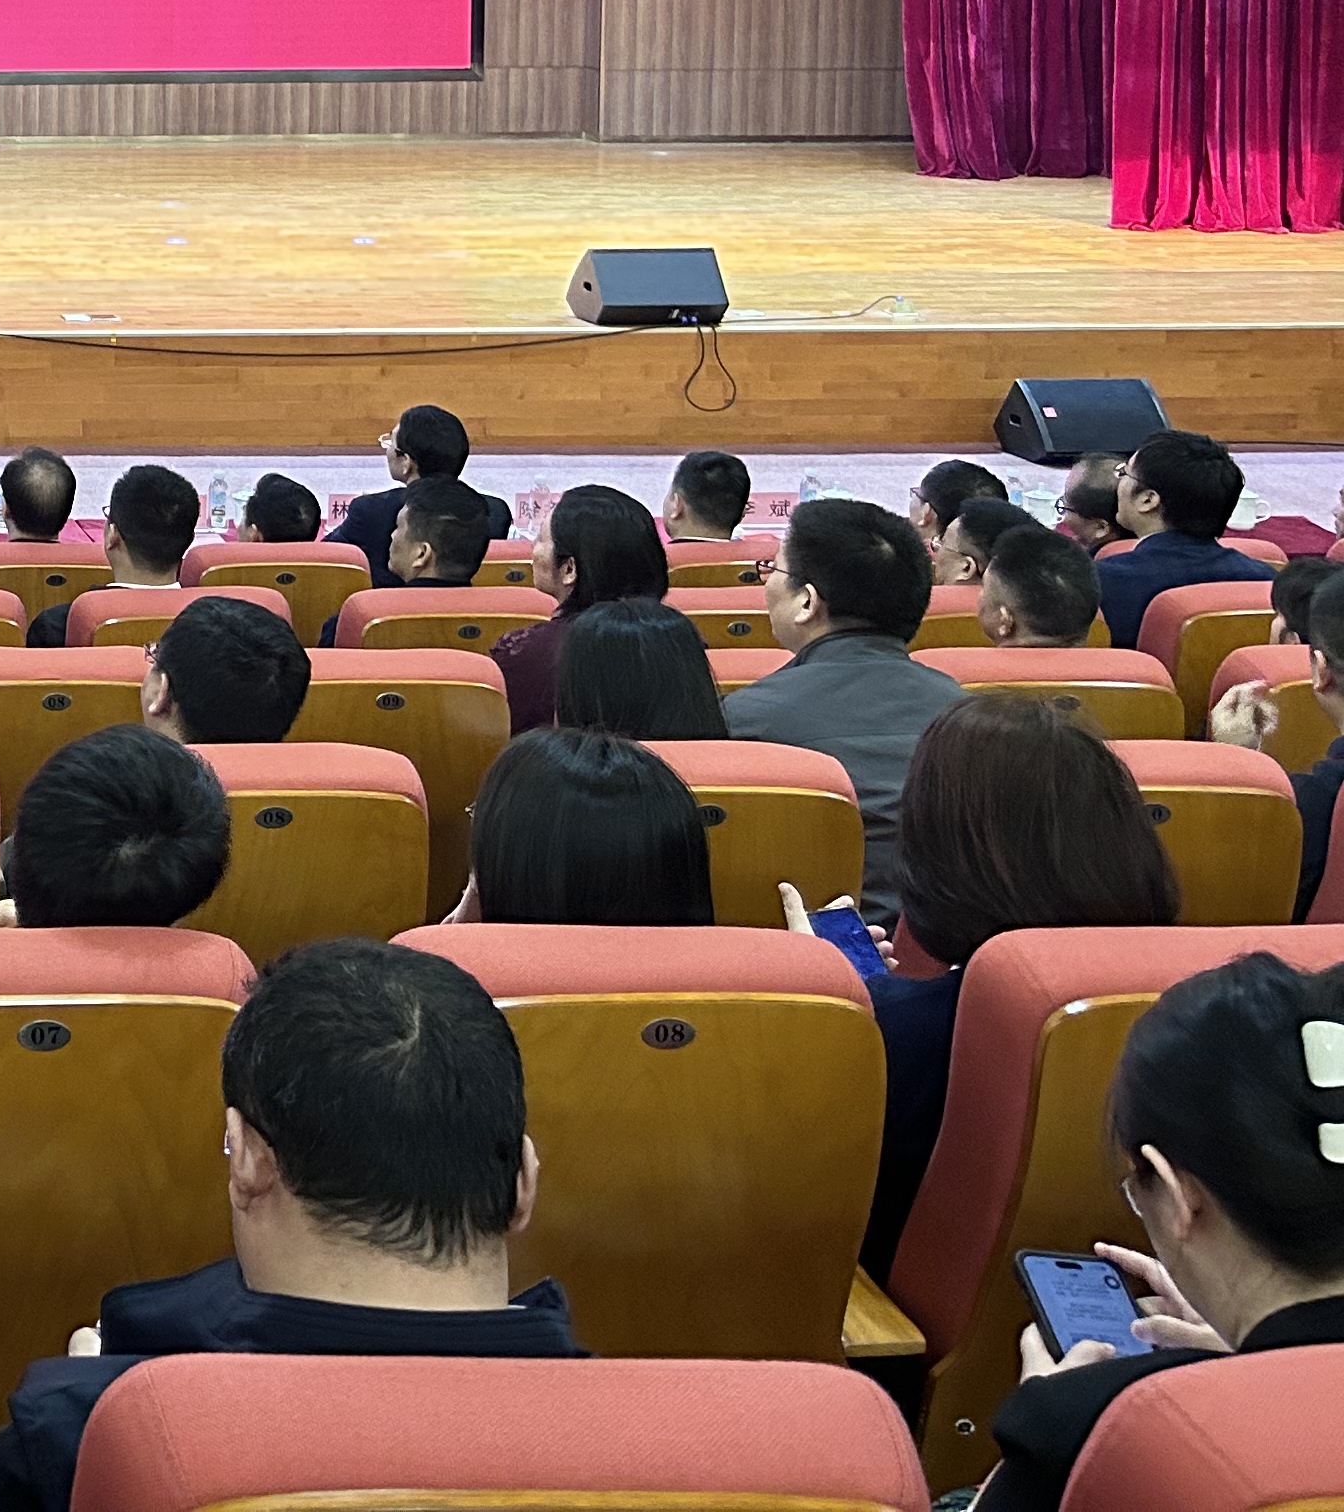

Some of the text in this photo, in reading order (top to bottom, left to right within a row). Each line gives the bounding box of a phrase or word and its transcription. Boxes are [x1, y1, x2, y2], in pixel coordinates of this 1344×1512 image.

[48, 696, 65, 709] 08
[382, 696, 400, 709] 09
[263, 812, 285, 826] 08
[30, 1025, 60, 1045] 07
[654, 1023, 685, 1042] 08
